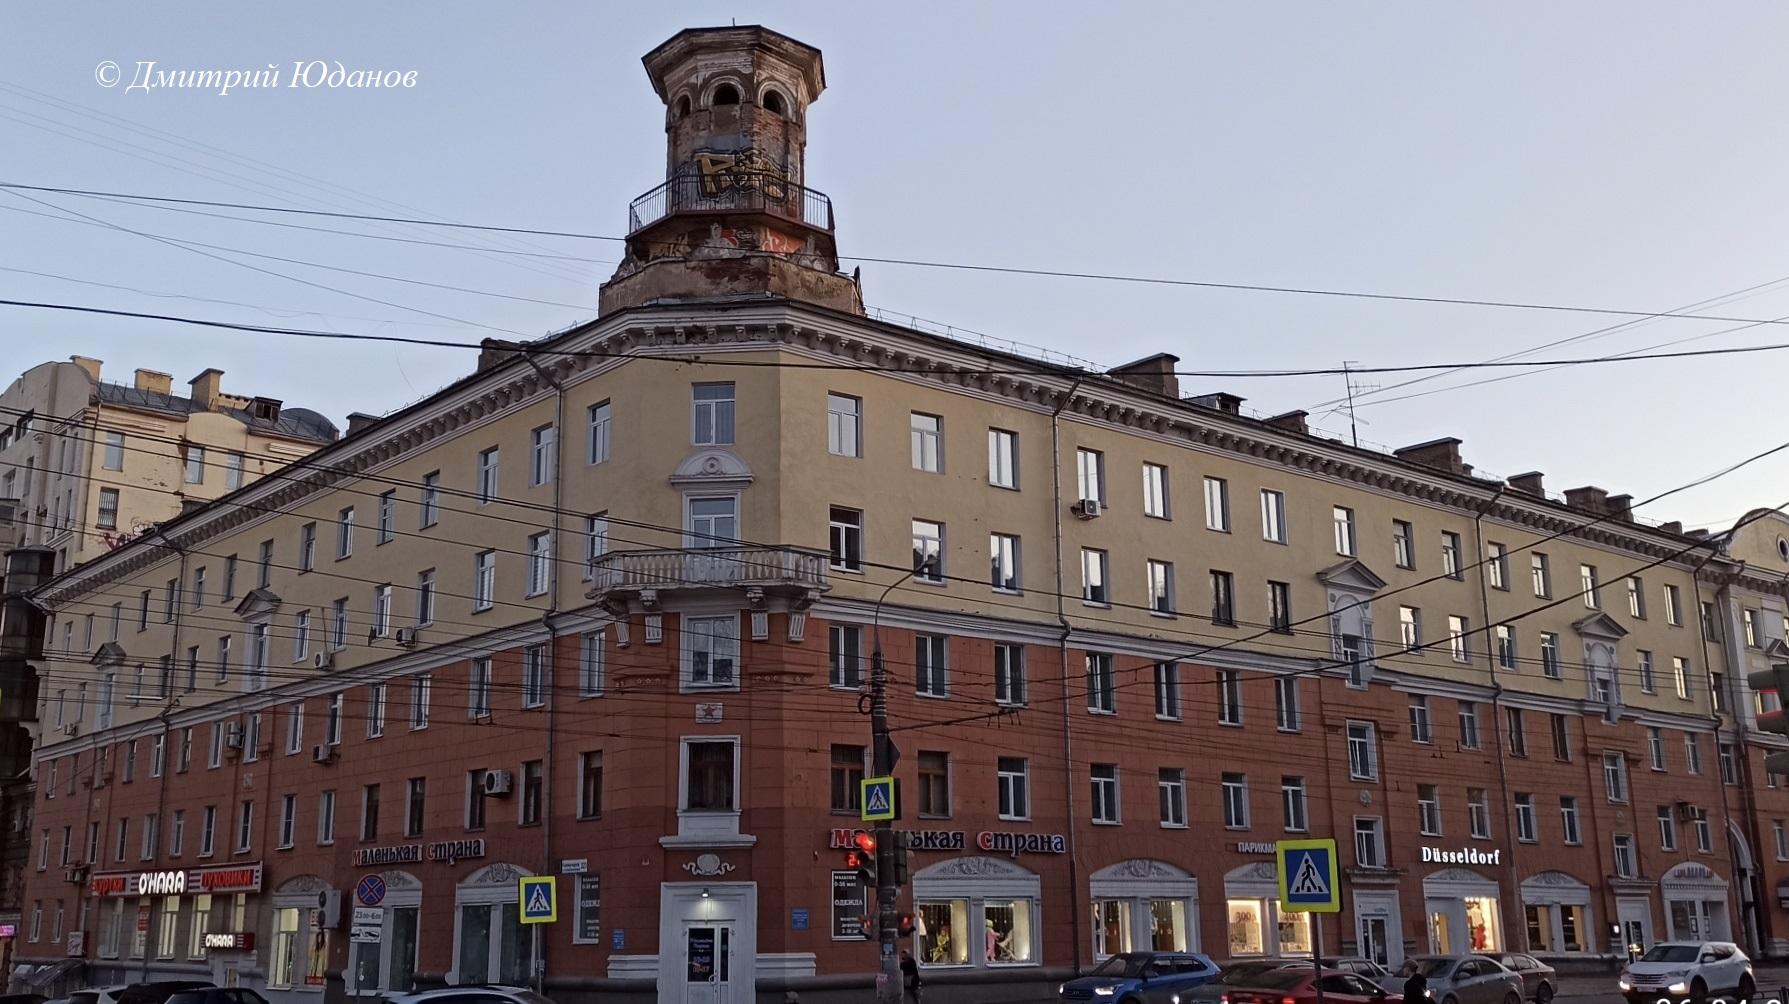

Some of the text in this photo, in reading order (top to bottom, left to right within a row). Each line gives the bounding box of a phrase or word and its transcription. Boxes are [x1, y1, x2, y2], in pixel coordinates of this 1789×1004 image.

[977, 831, 1066, 858] страна
[1421, 846, 1500, 865] Düsseldorf
[138, 870, 185, 895] O'HARA
